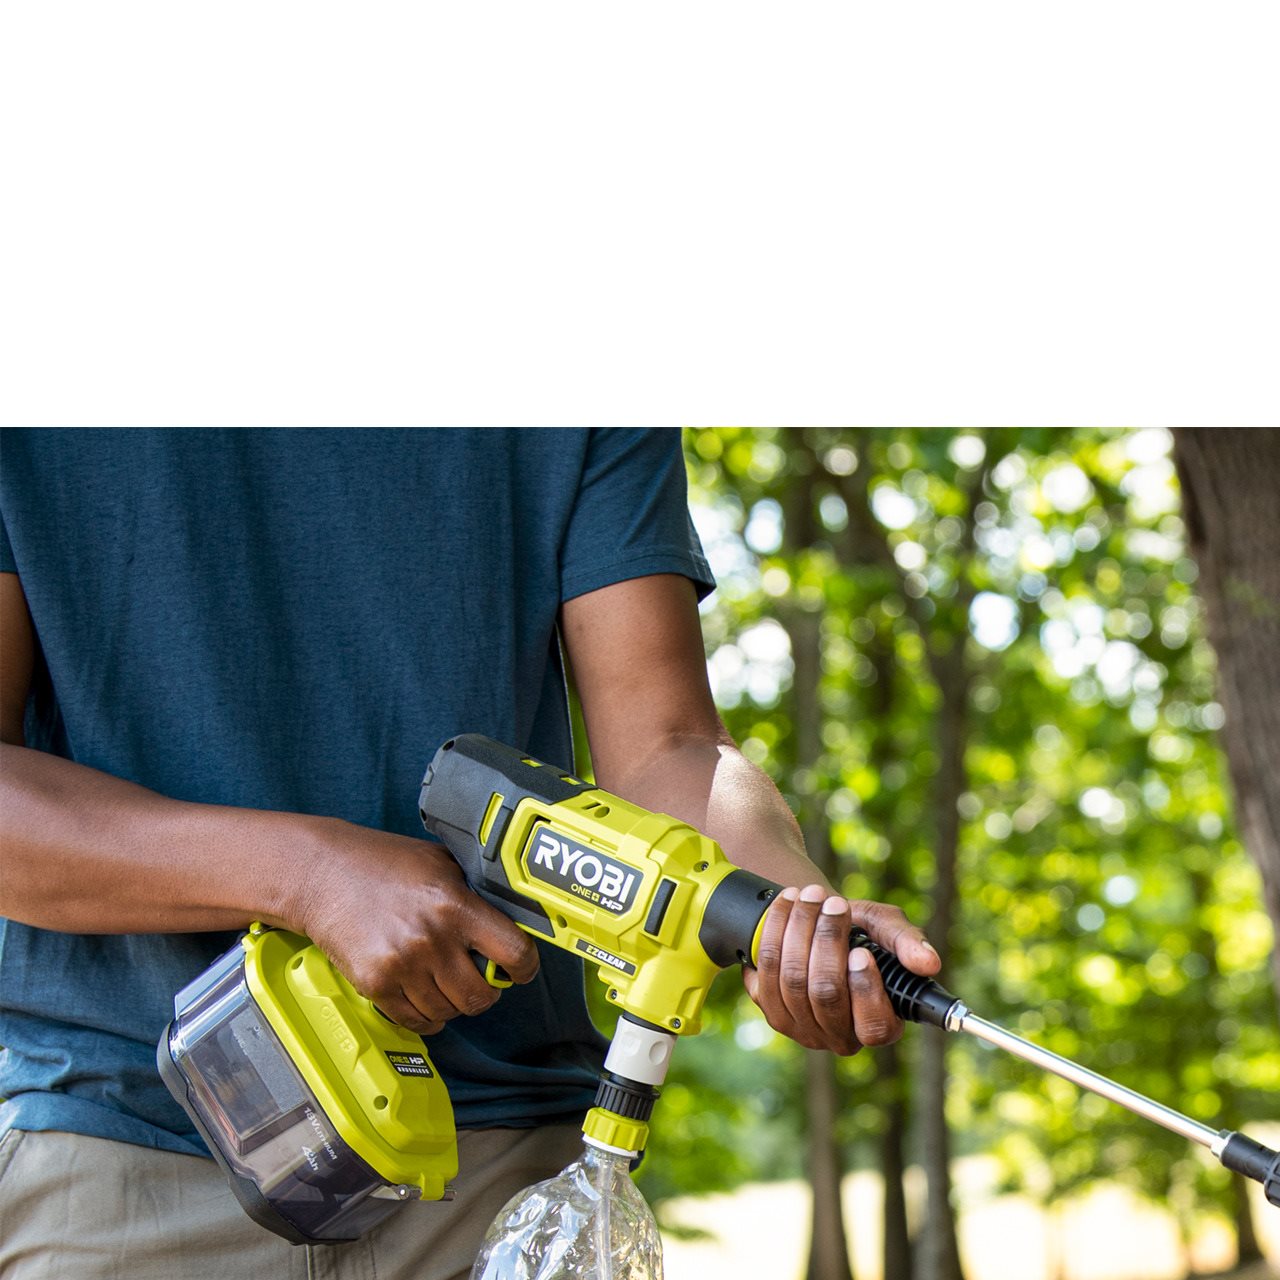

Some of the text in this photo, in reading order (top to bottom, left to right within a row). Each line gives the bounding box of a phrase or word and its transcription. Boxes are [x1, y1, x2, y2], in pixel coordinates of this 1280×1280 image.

[534, 833, 635, 904] RYOBI
[600, 897, 623, 911] HP
[409, 1056, 424, 1065] HP
